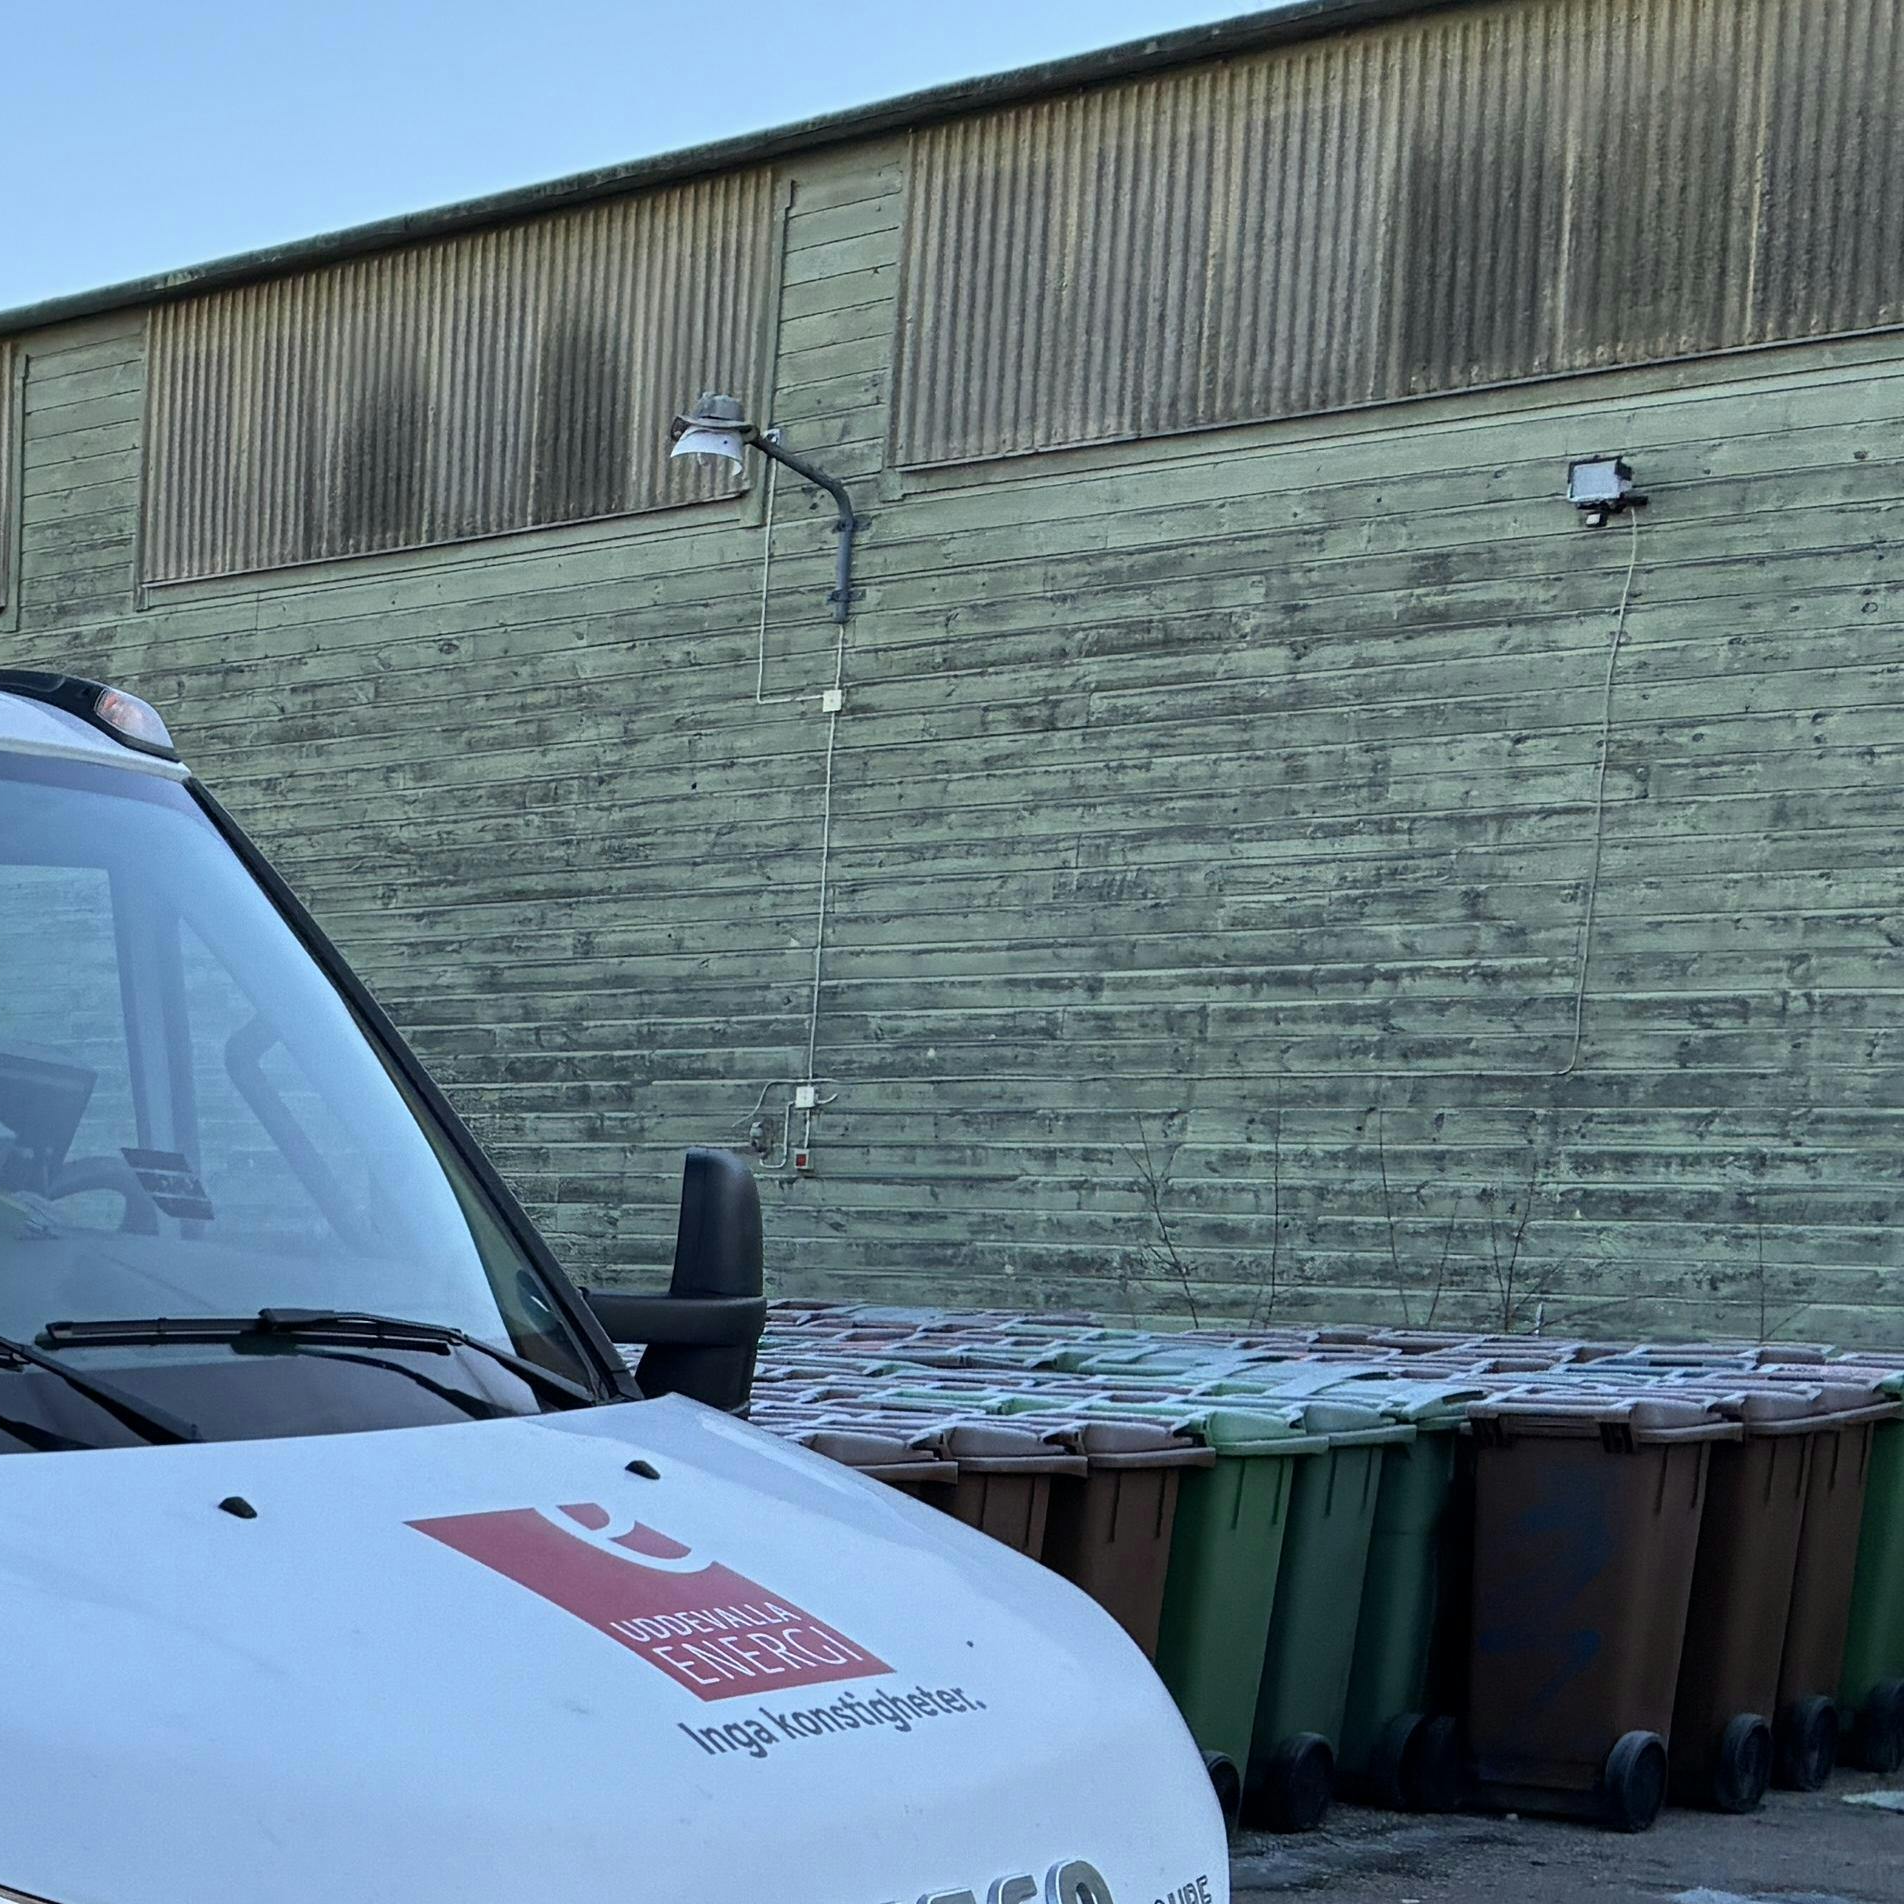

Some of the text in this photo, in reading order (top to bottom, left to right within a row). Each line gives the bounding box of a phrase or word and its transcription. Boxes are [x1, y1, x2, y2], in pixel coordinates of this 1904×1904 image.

[610, 1601, 802, 1643] UDDEVALLA
[651, 1626, 865, 1686] ENERGI
[677, 1684, 988, 1759] Inga konstigheter.
